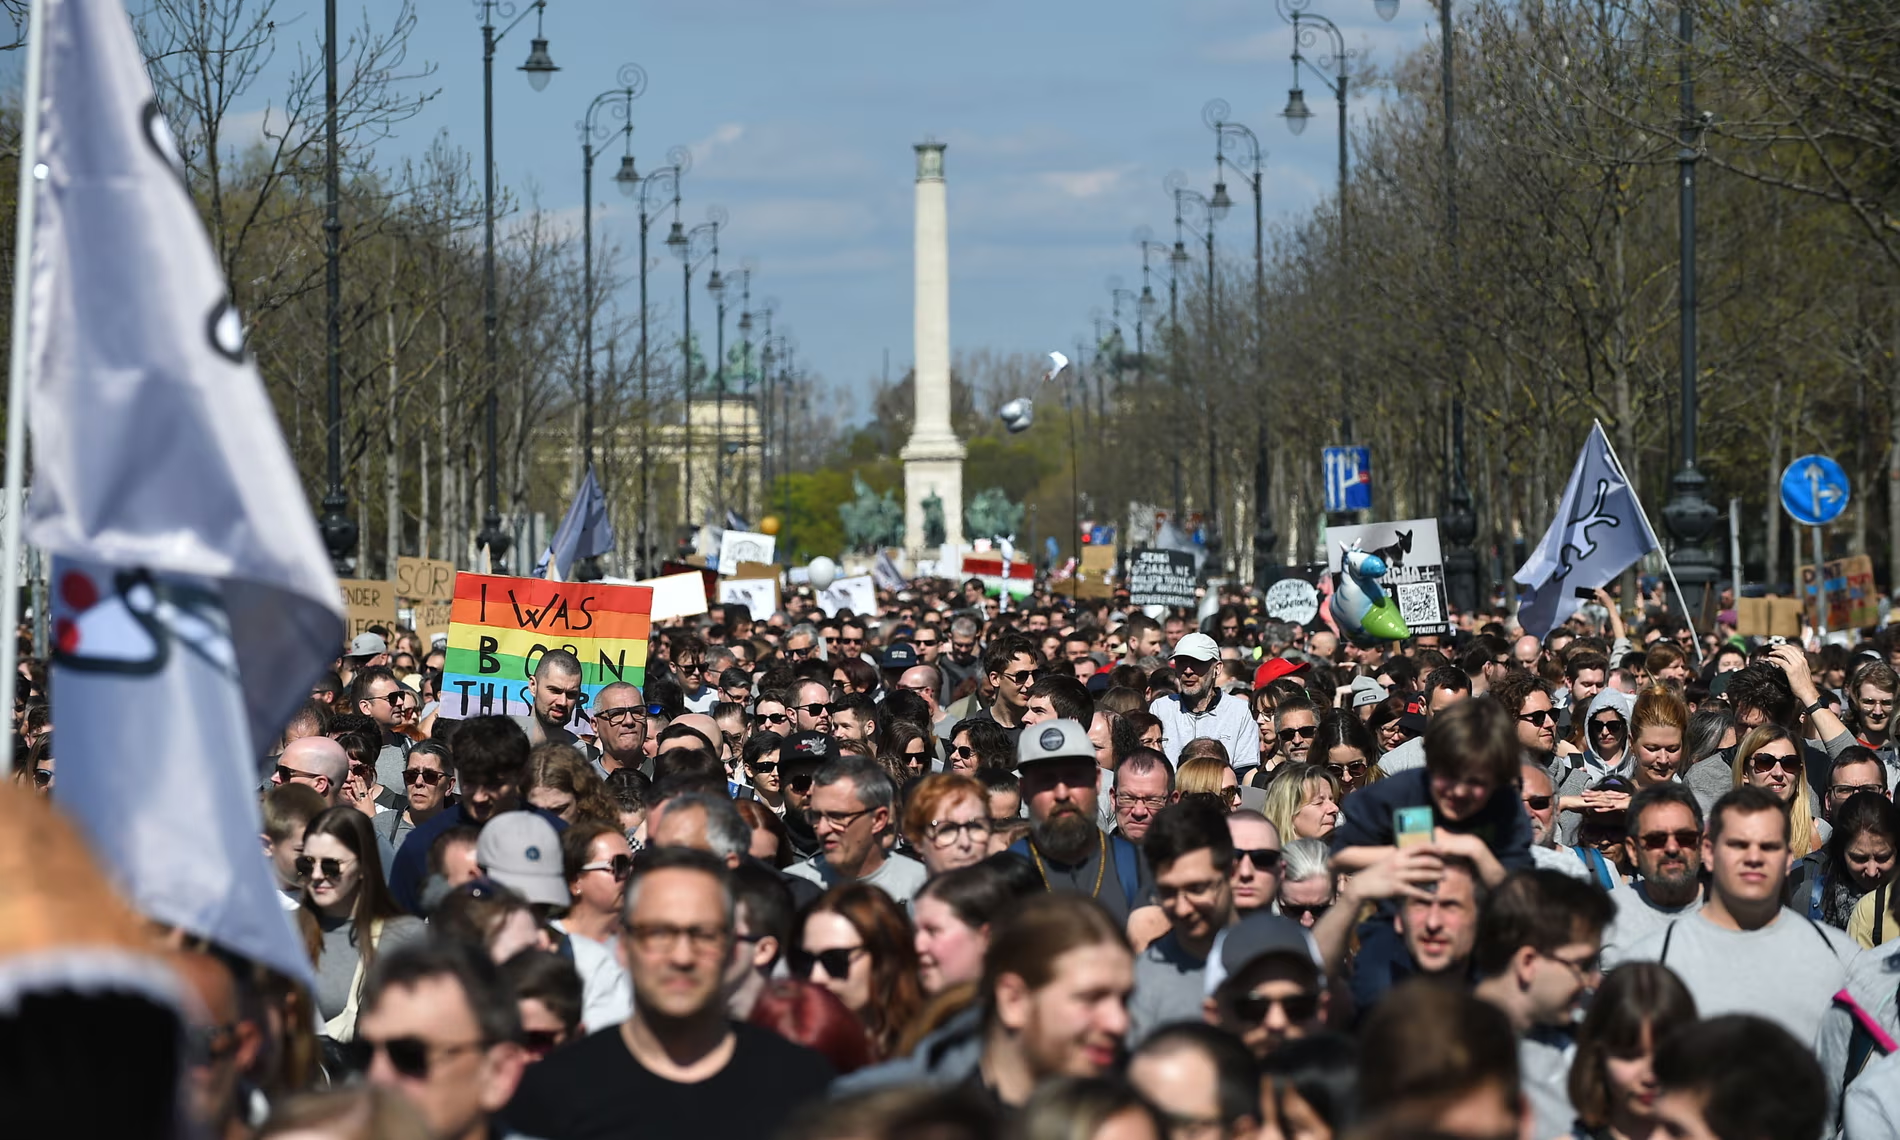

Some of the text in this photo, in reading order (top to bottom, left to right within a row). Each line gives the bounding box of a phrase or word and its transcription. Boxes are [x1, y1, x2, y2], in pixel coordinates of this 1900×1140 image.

[340, 586, 381, 607] ENDER
[396, 562, 449, 597] SÖR
[480, 584, 487, 622] I
[508, 589, 595, 630] WAS
[479, 635, 626, 682] BON
